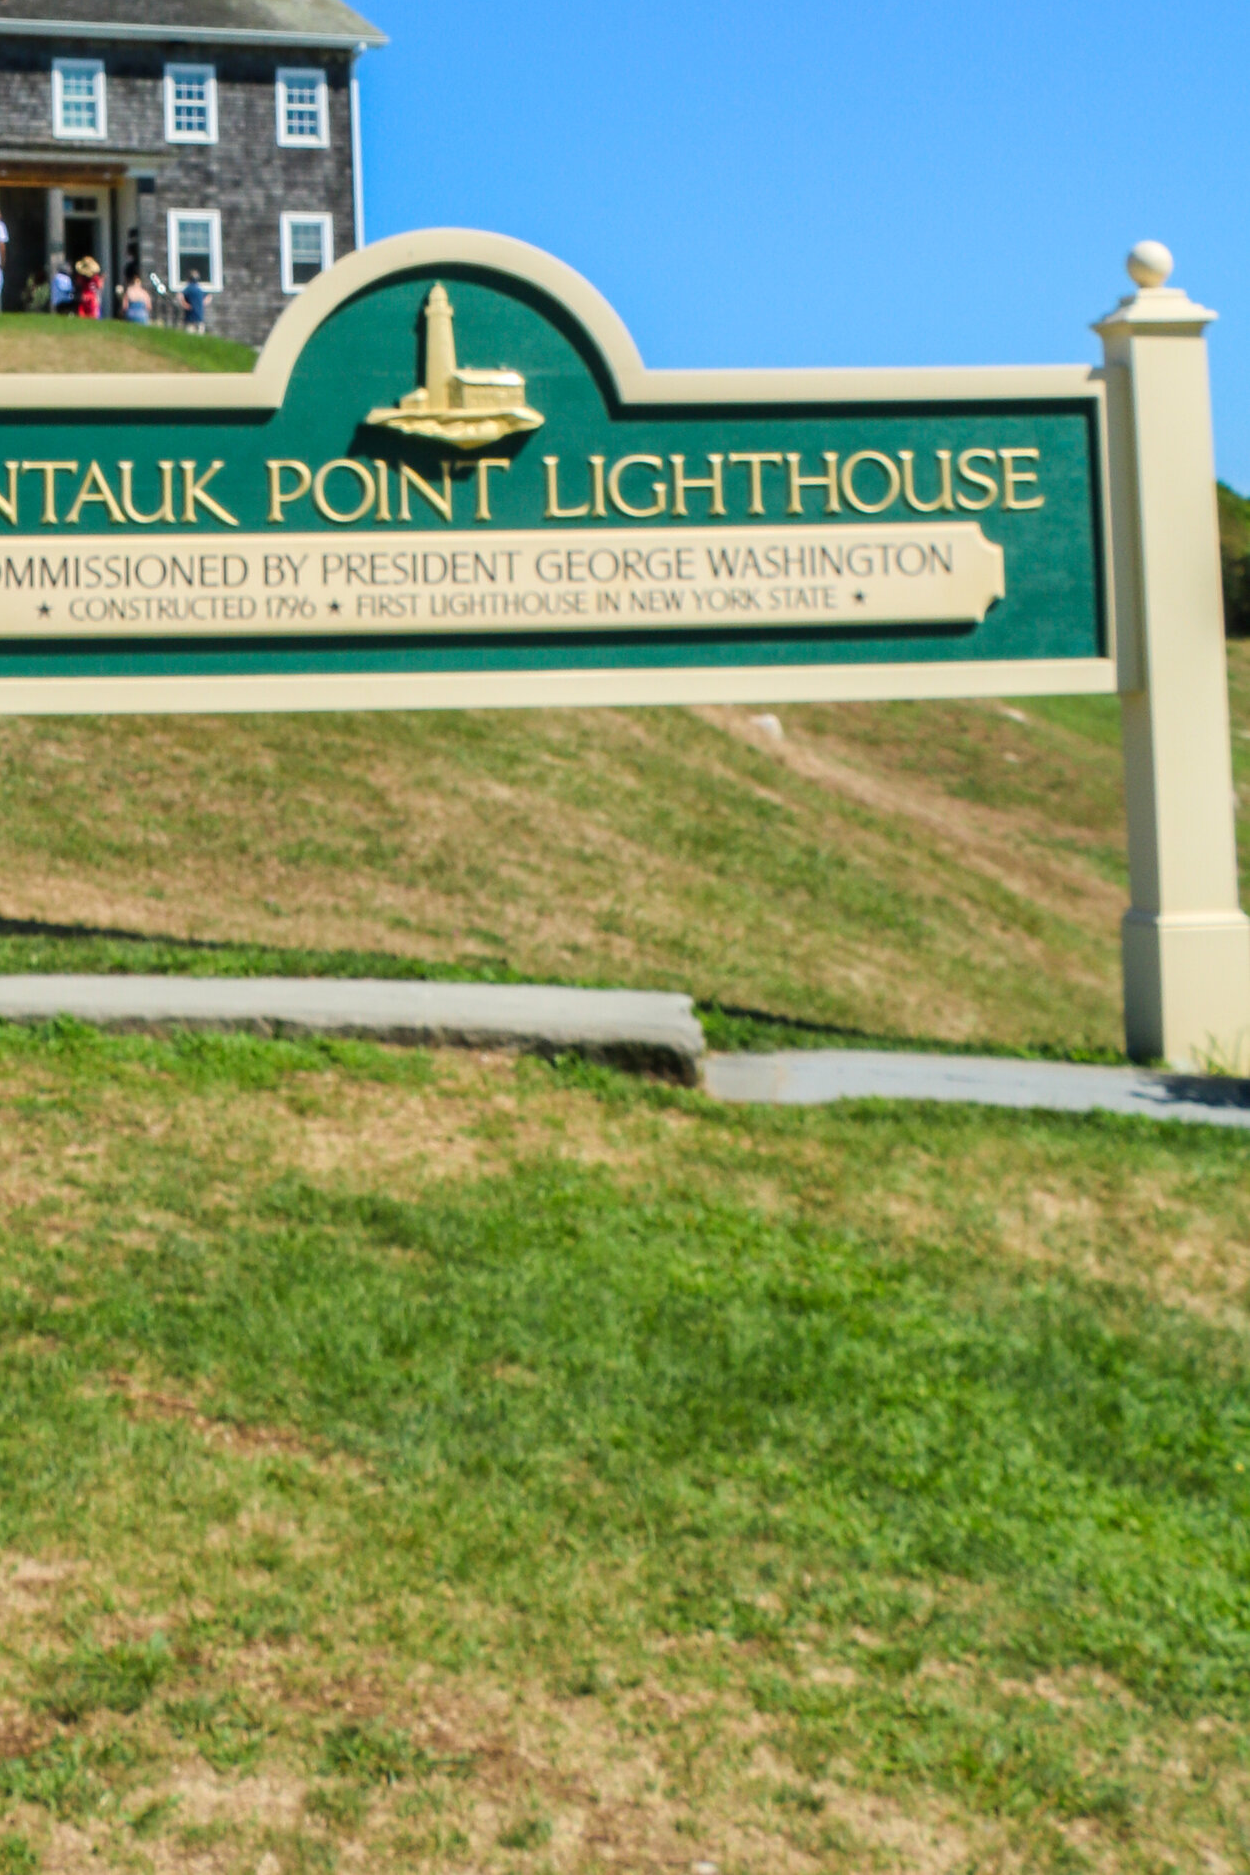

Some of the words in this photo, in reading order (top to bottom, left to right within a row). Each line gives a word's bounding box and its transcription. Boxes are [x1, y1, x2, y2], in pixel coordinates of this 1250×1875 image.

[265, 457, 511, 524] POINT
[542, 448, 1044, 518] LIGHTHOUSE
[264, 554, 307, 587] BY
[322, 551, 521, 587] PRESIDENT
[535, 547, 696, 583] GEORGE
[707, 541, 954, 580] WASHINGTON
[68, 596, 257, 622] CONSTRUCTED
[264, 595, 317, 619] 1796
[355, 592, 424, 619] FIRST
[430, 588, 589, 618] LIGHTHOUSE
[596, 588, 621, 614] IN
[629, 587, 686, 613] NEW
[690, 586, 762, 612] YORK
[767, 585, 839, 611] STATE
